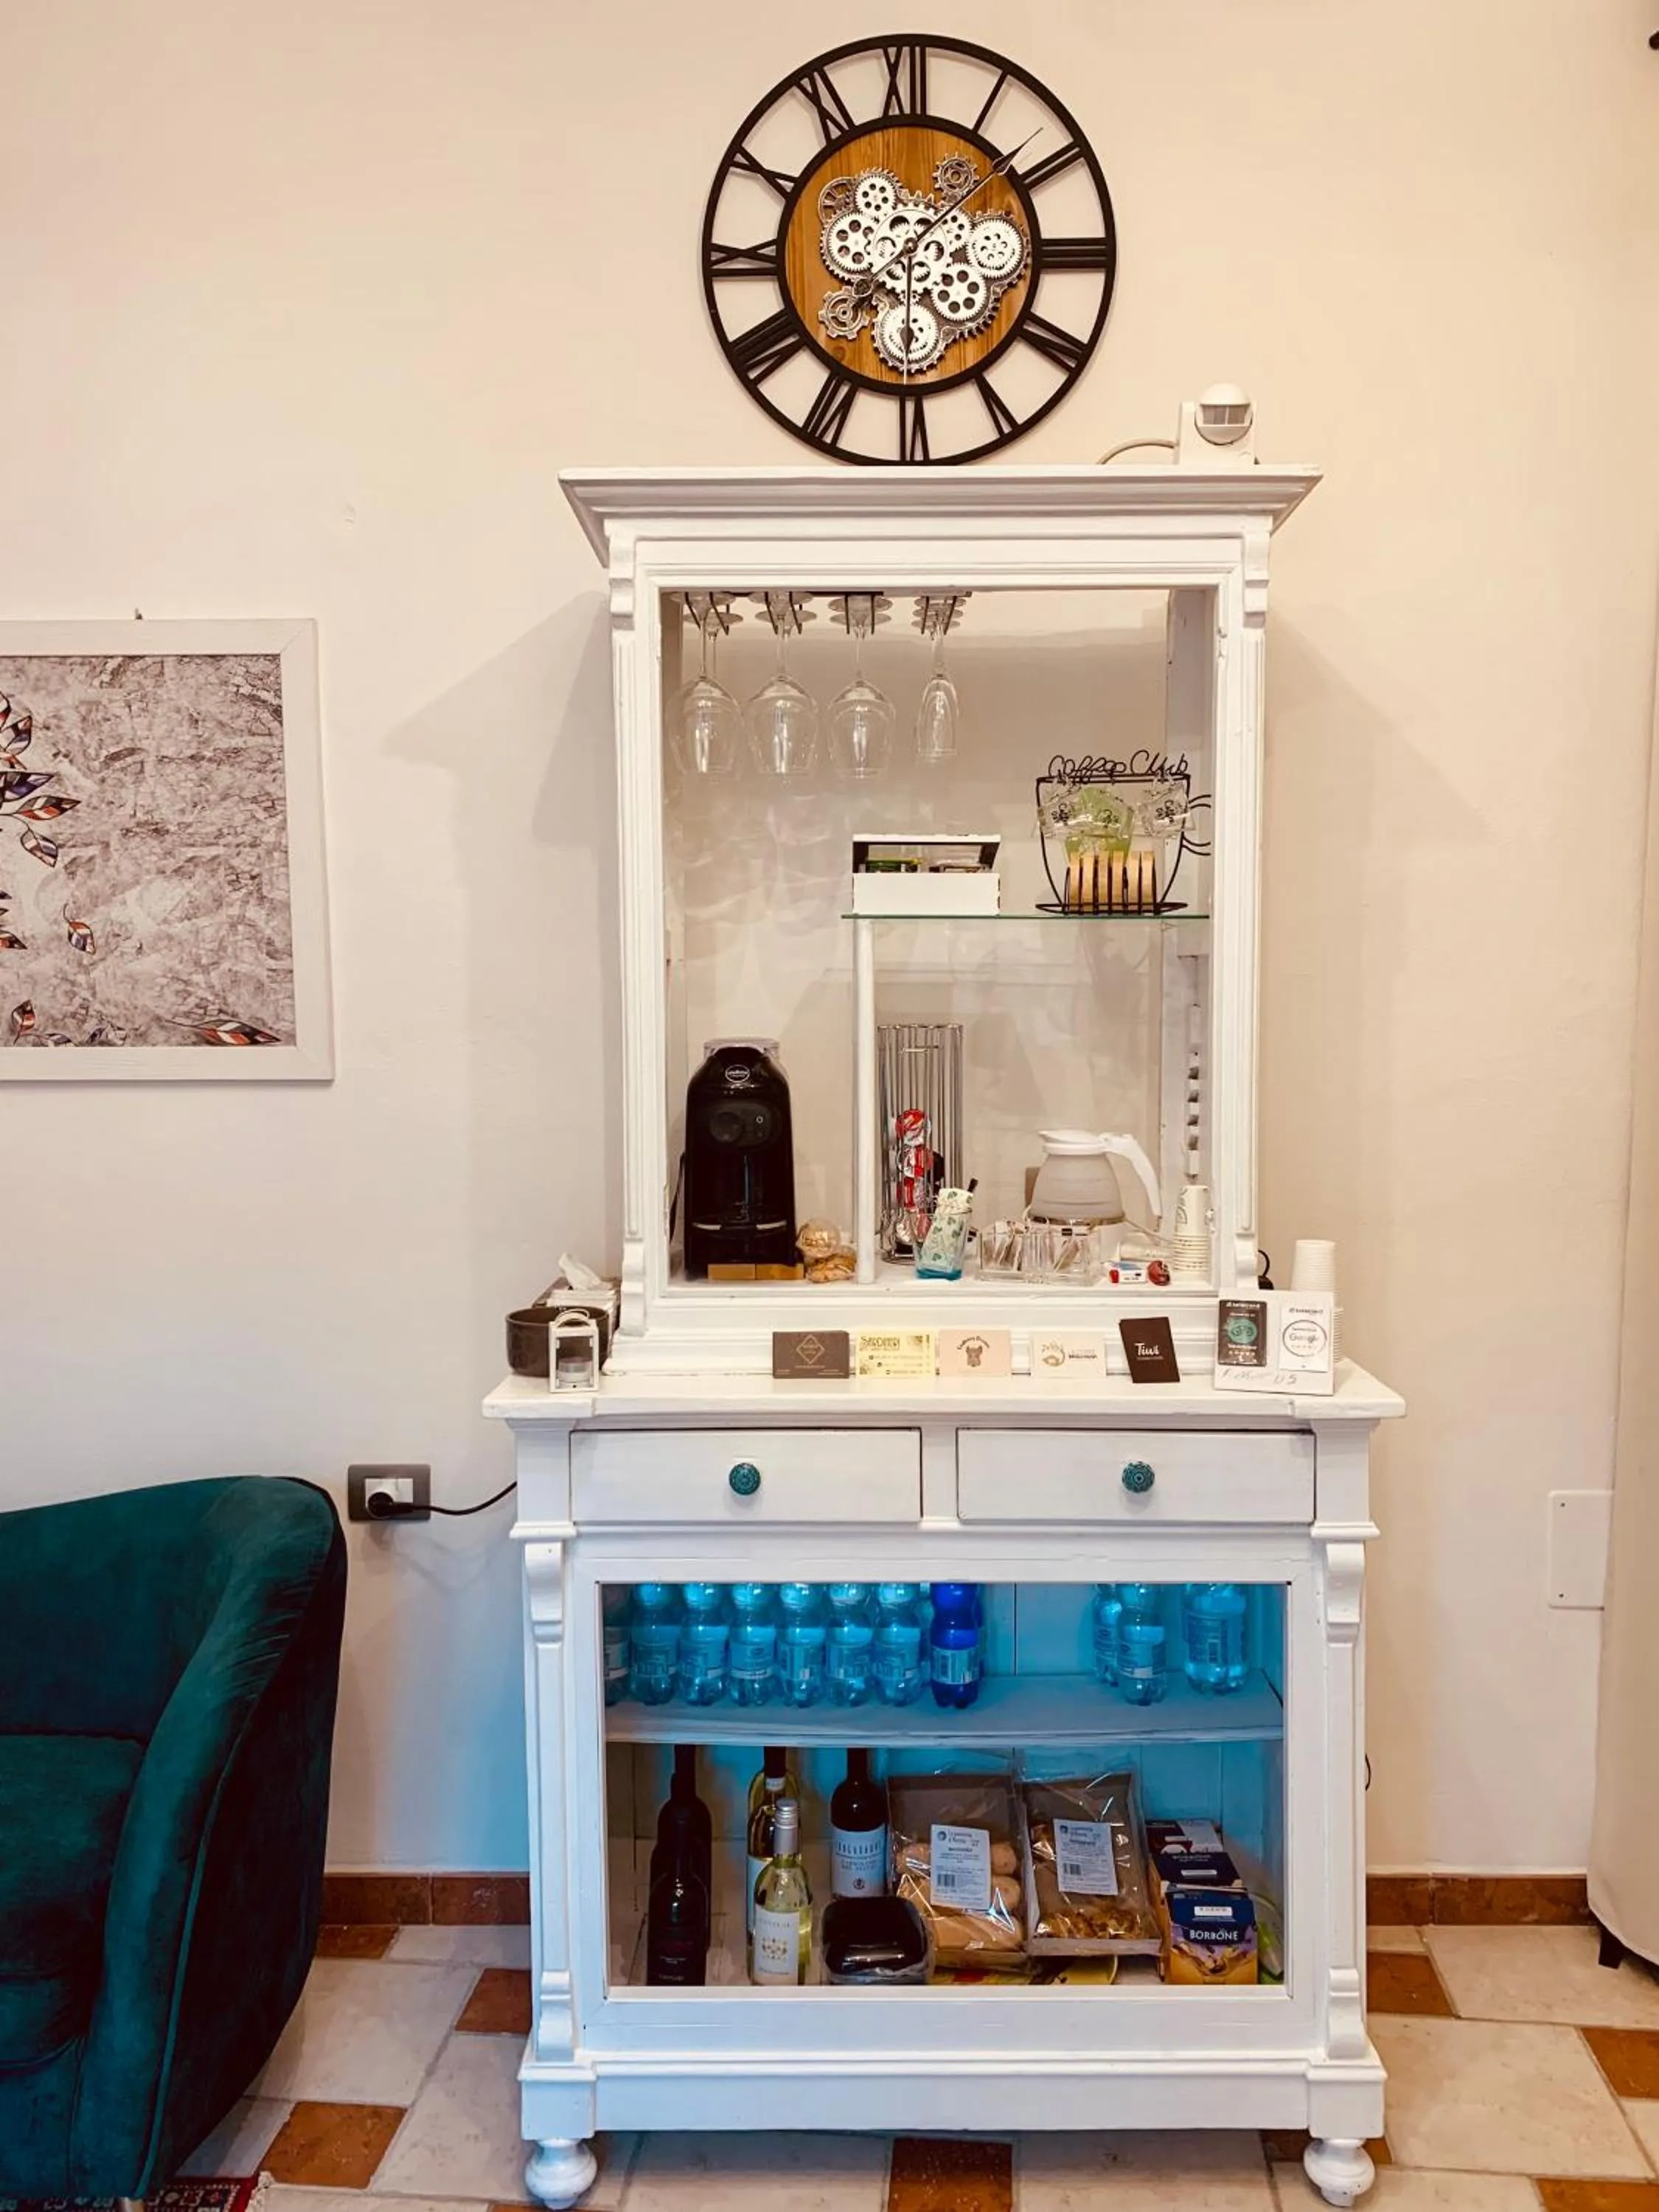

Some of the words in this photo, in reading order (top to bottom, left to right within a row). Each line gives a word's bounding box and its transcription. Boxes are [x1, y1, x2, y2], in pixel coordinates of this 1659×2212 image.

[883, 46, 927, 115] XII
[795, 67, 857, 146] XI
[729, 146, 799, 199] X
[1021, 139, 1086, 189] II
[1038, 237, 1107, 269] III
[1189, 1929, 1239, 1941] BORBONE
